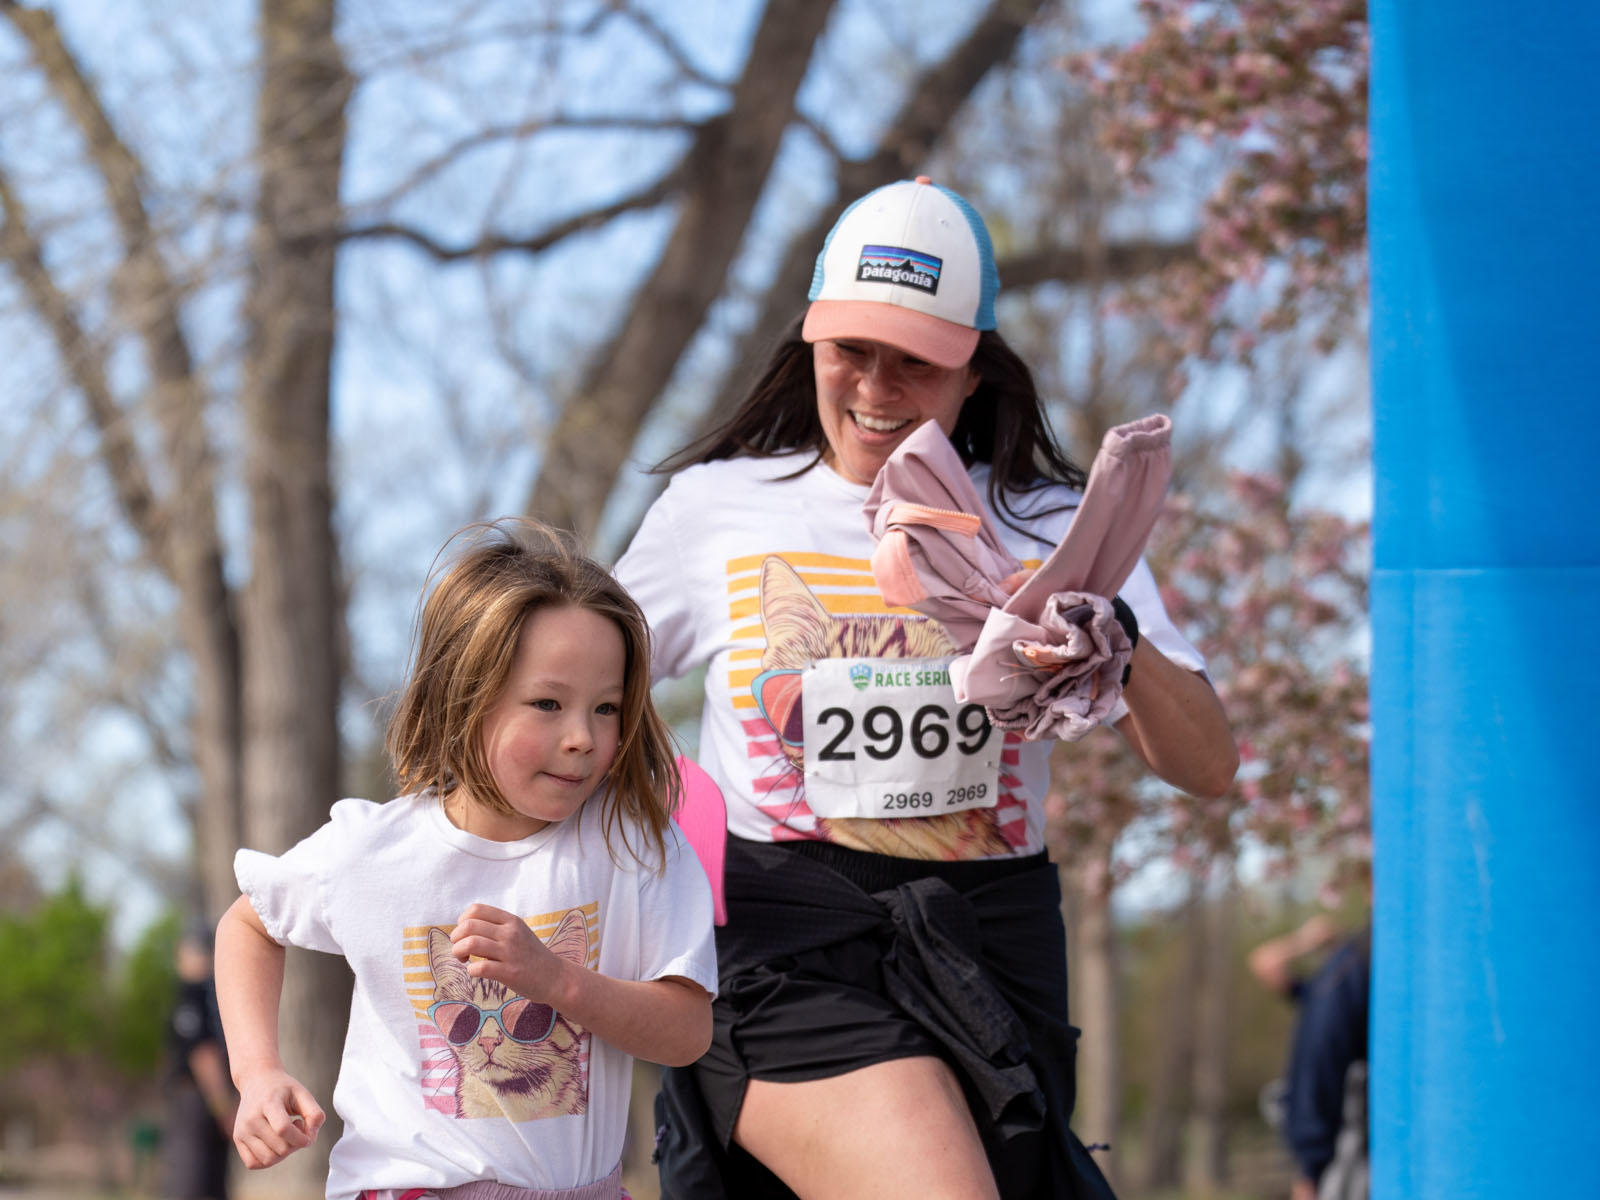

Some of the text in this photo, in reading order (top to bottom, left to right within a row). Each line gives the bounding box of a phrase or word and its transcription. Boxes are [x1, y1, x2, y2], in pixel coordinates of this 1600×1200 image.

[861, 265, 932, 288] patagonia
[875, 671, 912, 687] RACE
[816, 703, 993, 762] 2969
[883, 783, 988, 810] 2969 2969
